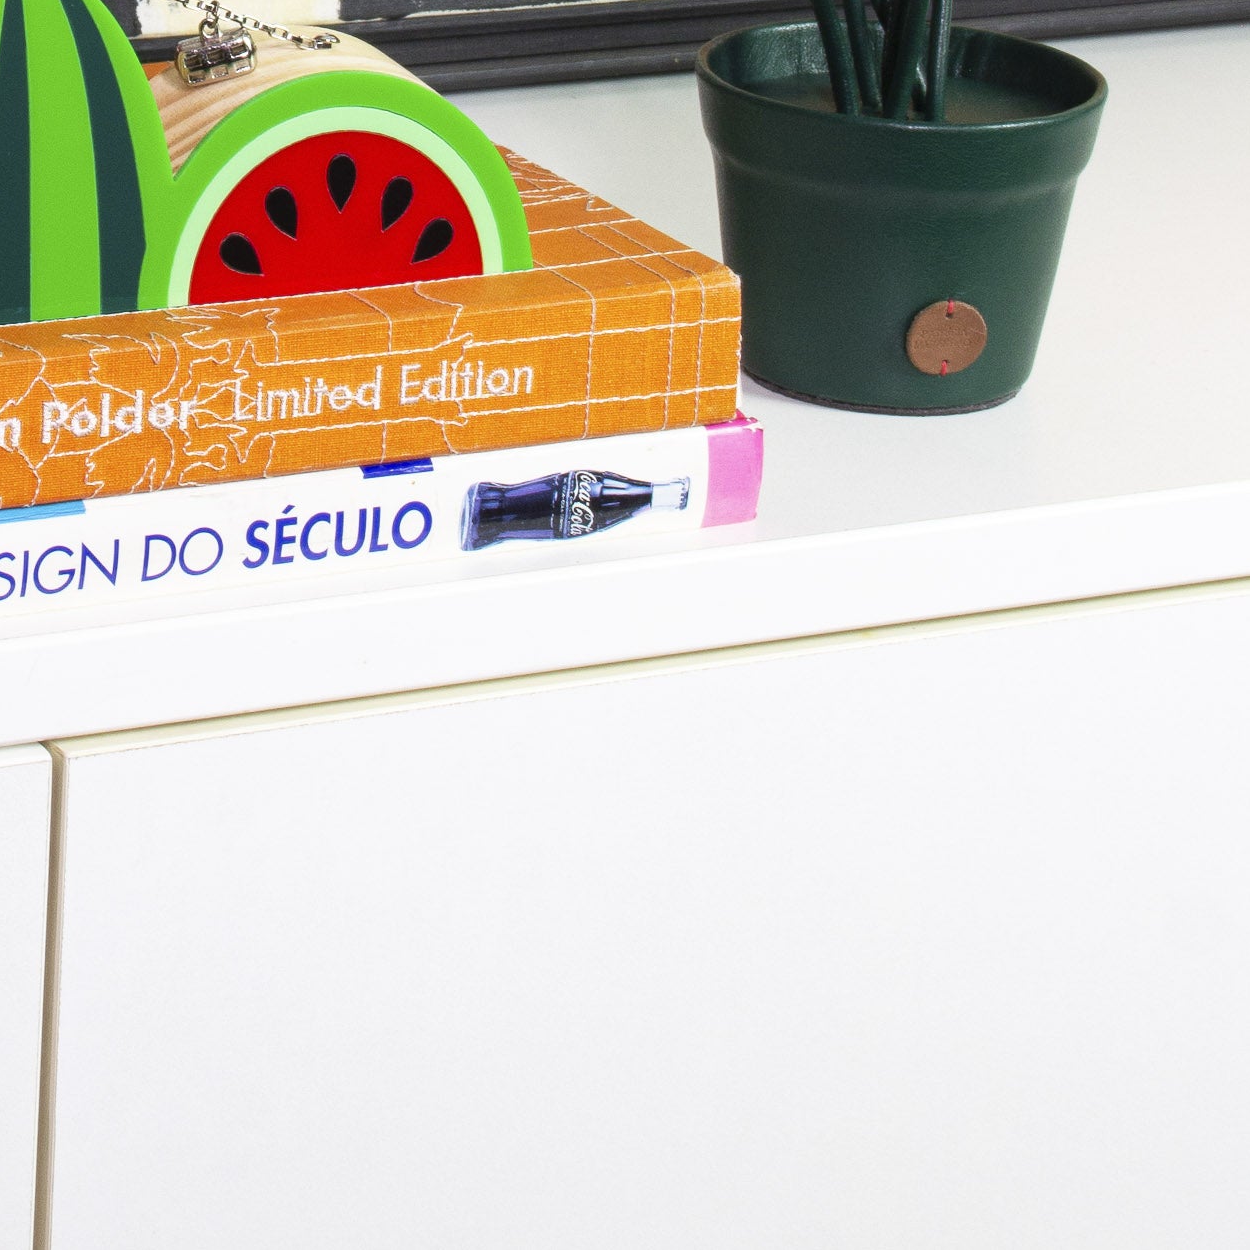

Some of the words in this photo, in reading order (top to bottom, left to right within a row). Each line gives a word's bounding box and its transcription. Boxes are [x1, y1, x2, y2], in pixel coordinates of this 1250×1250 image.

[40, 389, 195, 444] Polder
[233, 364, 383, 422] Limited
[399, 360, 534, 406] Edition
[141, 526, 224, 582] DO
[241, 500, 433, 569] SÉCULO
